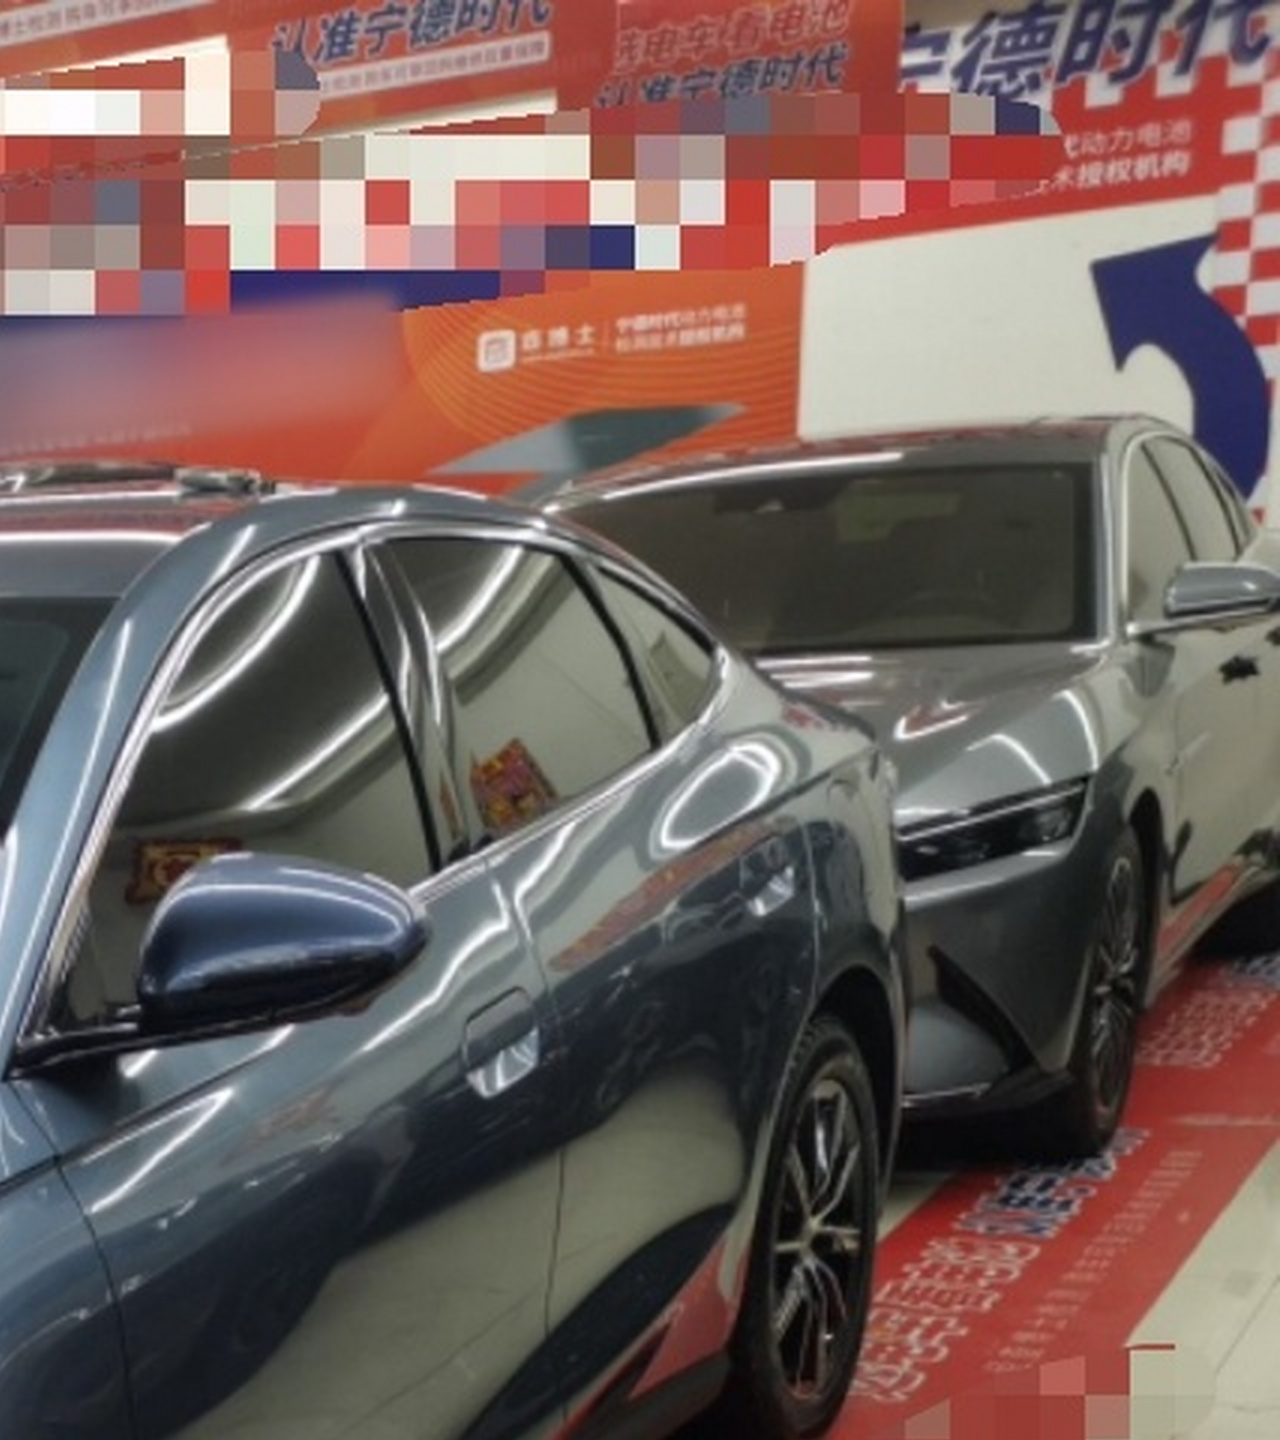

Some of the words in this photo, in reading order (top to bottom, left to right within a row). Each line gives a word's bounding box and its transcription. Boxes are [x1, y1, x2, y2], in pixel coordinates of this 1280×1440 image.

[1030, 150, 1190, 196] 术授权机构
